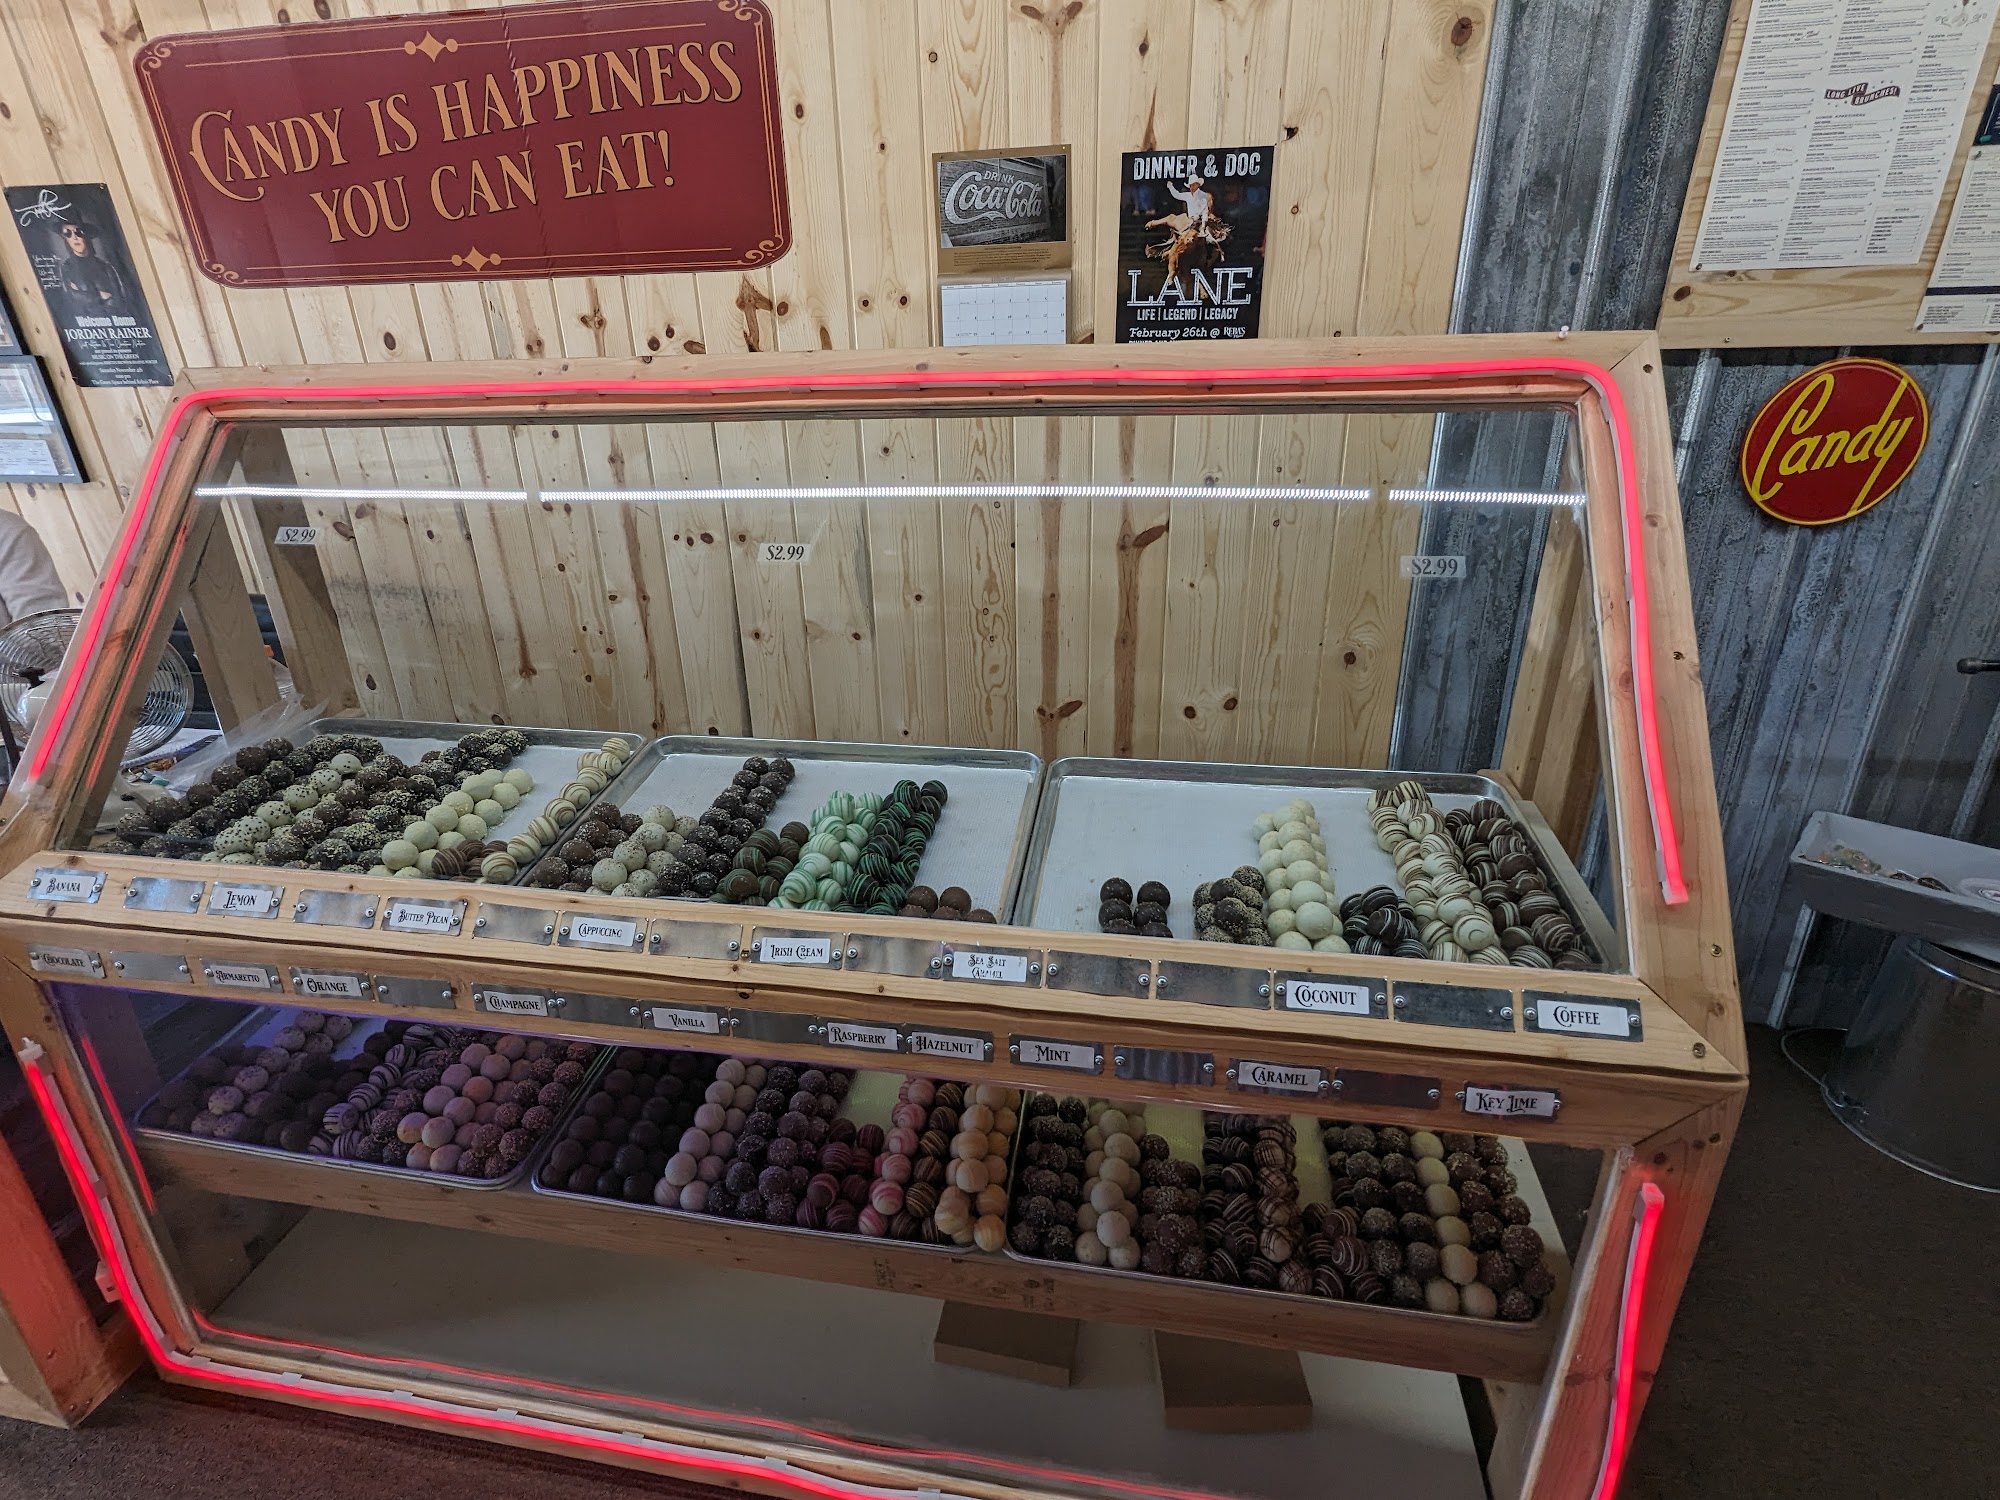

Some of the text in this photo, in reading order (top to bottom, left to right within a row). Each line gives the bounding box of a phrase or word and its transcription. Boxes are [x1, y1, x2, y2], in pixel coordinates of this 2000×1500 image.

[1826, 83, 1866, 99] LONG LIVE
[1854, 87, 1898, 105] BRUNCHES!
[188, 40, 744, 202] CANDY IS HAPPINESS
[1133, 152, 1261, 181] DINNER & DOC
[983, 170, 1015, 184] DRINK
[310, 129, 676, 245] YOU CAN EAT!
[944, 171, 1044, 225] Coca-Cola
[1126, 267, 1253, 307] LANE
[75, 315, 136, 327] Welcome Home
[1136, 307, 1239, 321] LIFE LEGEND LEGACY
[64, 327, 152, 342] JORDAN RAINER
[1129, 327, 1181, 340] February
[1181, 327, 1208, 338] 26th
[1209, 327, 1221, 339] @
[1751, 372, 1915, 516] Candy
[766, 544, 805, 561] $2.99
[1411, 558, 1459, 576] $2.99
[46, 875, 81, 894] BANANA
[222, 891, 258, 910] LEMON
[425, 911, 450, 925] PECAN
[42, 953, 86, 968] CHOCOLATE
[770, 944, 793, 959] IRISH
[967, 954, 985, 967] SEA
[306, 977, 348, 993] ORANGE
[488, 995, 541, 1011] CHAMPAGNE
[1293, 984, 1358, 1007] COCONUT
[668, 1014, 705, 1029] VANILLA
[1552, 1005, 1602, 1028] COFFEE
[830, 1026, 887, 1045] RASPBERRY
[915, 1036, 974, 1054] HAZELNUT
[1034, 1044, 1071, 1063] MINT
[1251, 1066, 1309, 1086] CARAMEL
[1476, 1092, 1538, 1113] KEY LIME
